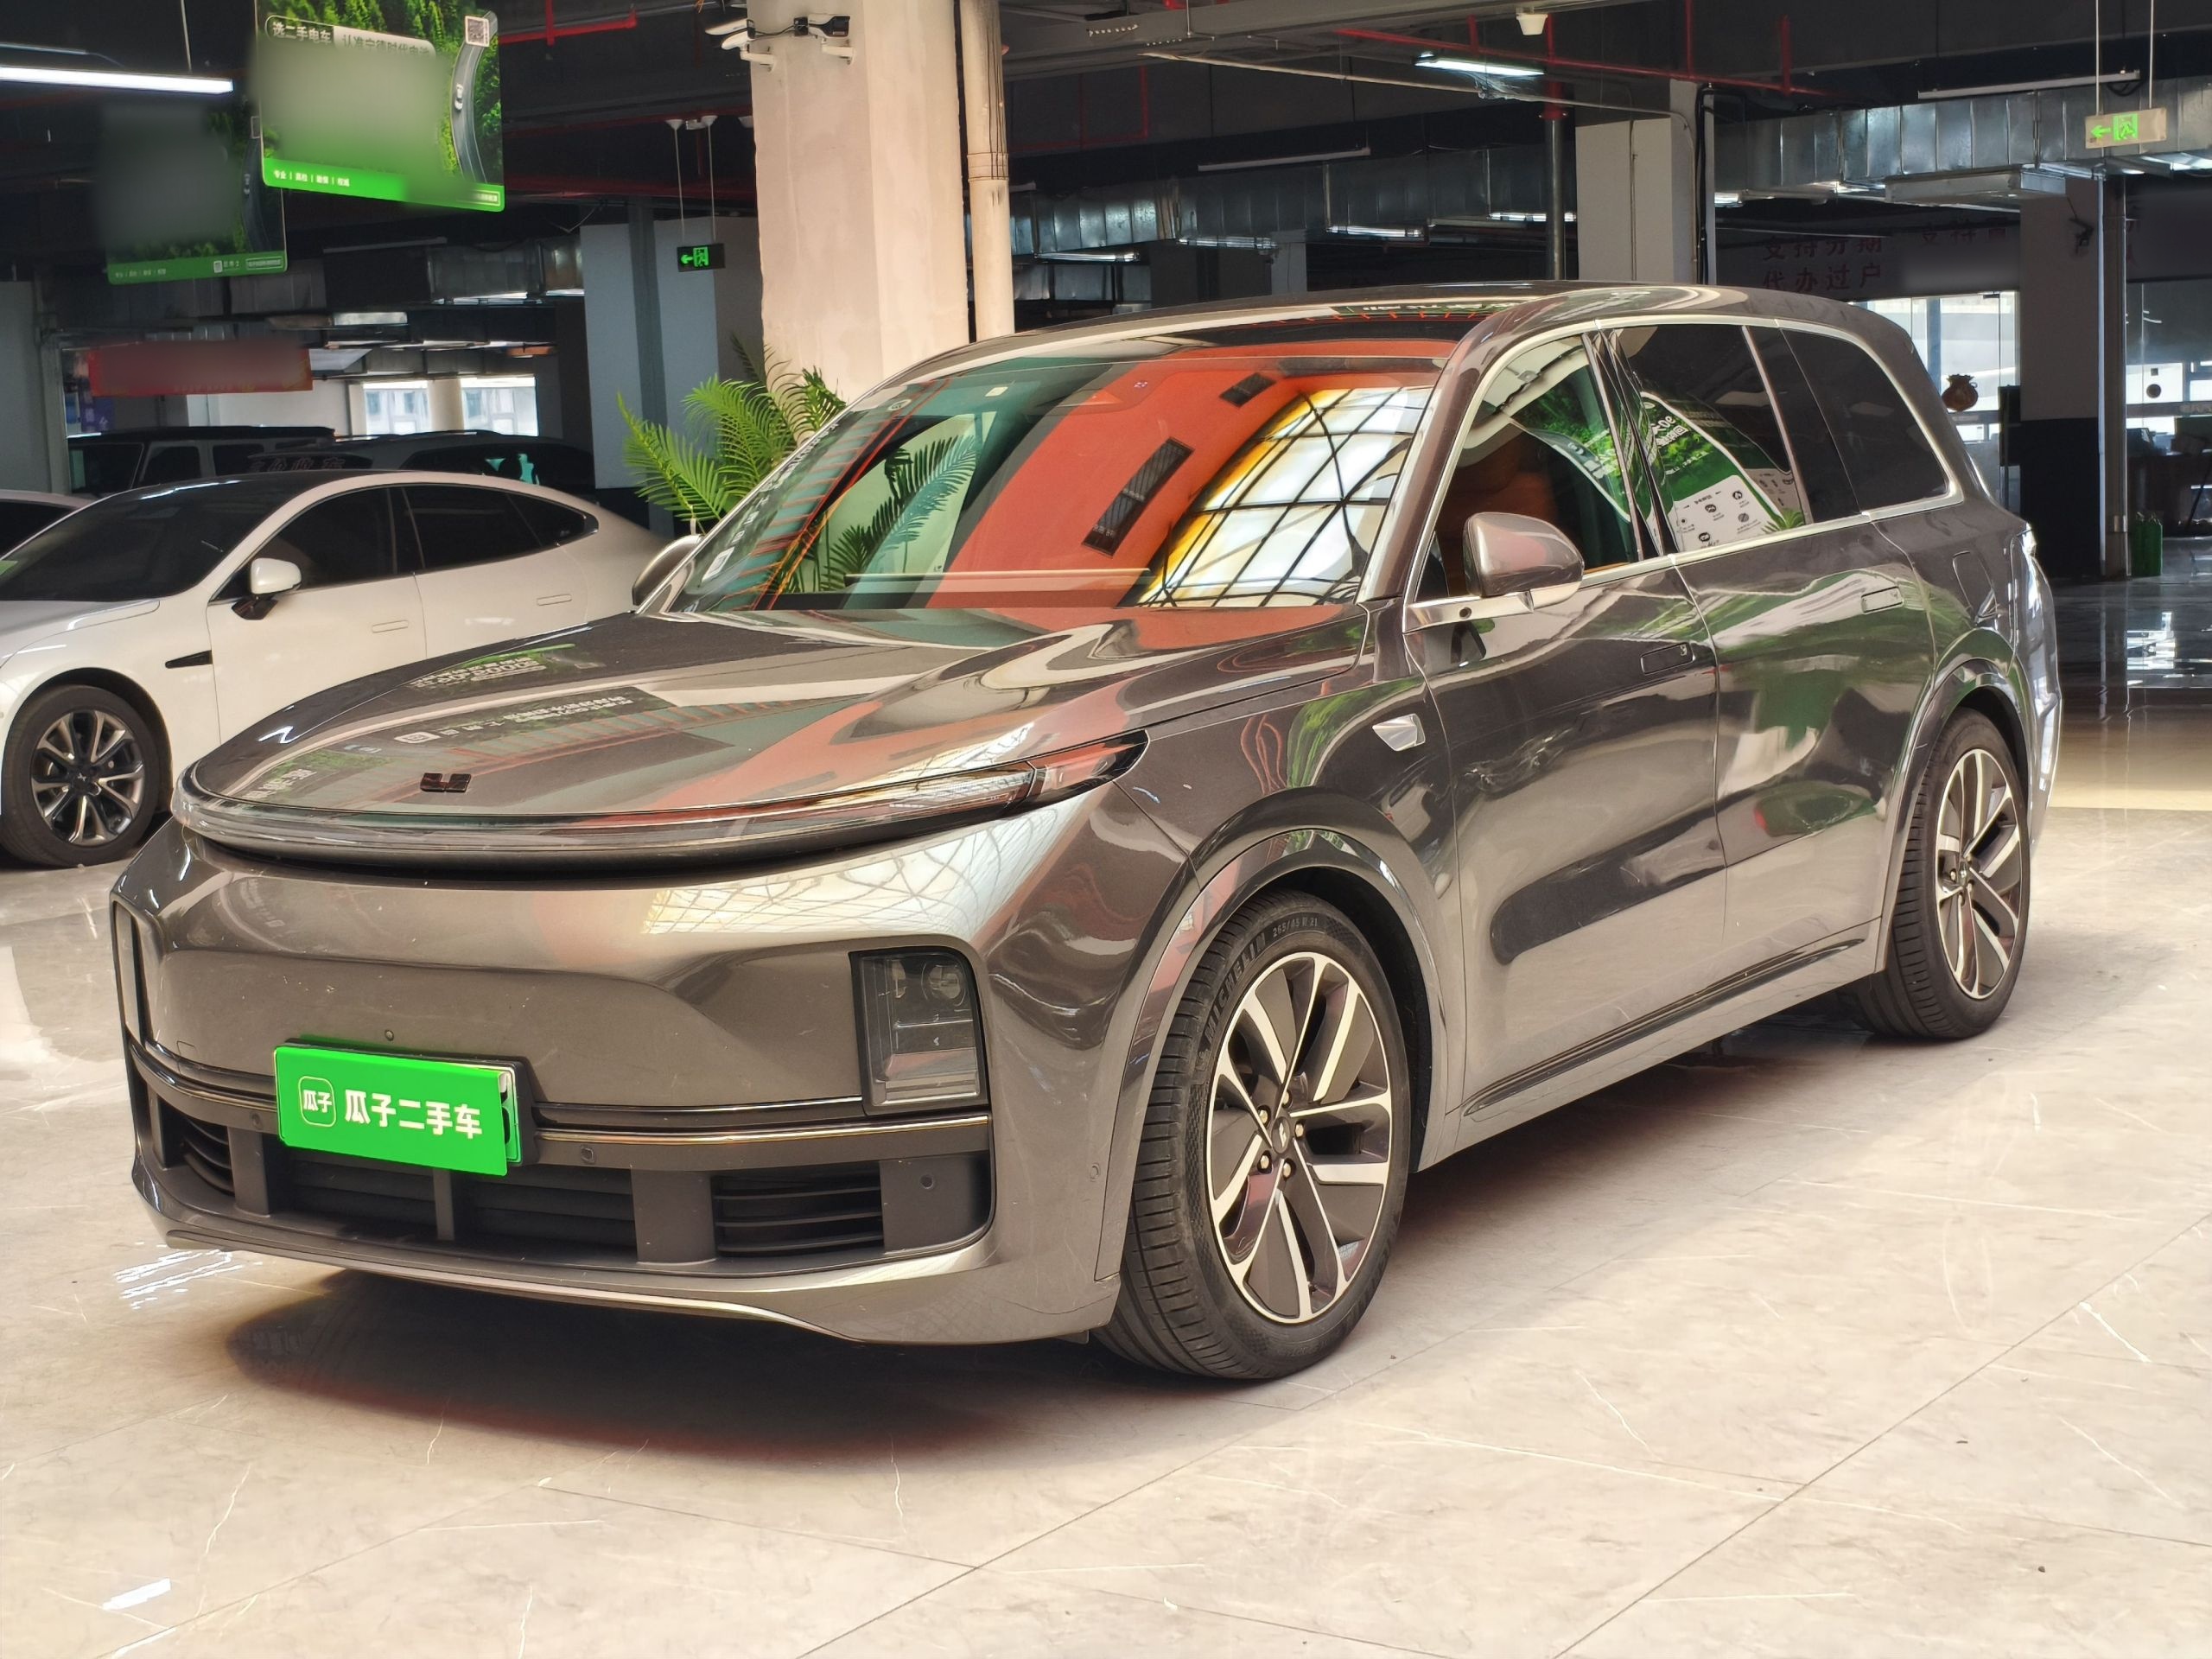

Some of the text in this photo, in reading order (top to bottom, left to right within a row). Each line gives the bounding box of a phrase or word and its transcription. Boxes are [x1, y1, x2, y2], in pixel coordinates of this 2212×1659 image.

[272, 21, 332, 44] 选二手电车
[1763, 263, 1881, 292] 代办过户
[1205, 932, 1266, 1042] MICHELIN
[303, 1090, 332, 1113] 瓜子
[345, 1090, 482, 1139] 瓜子二手车
